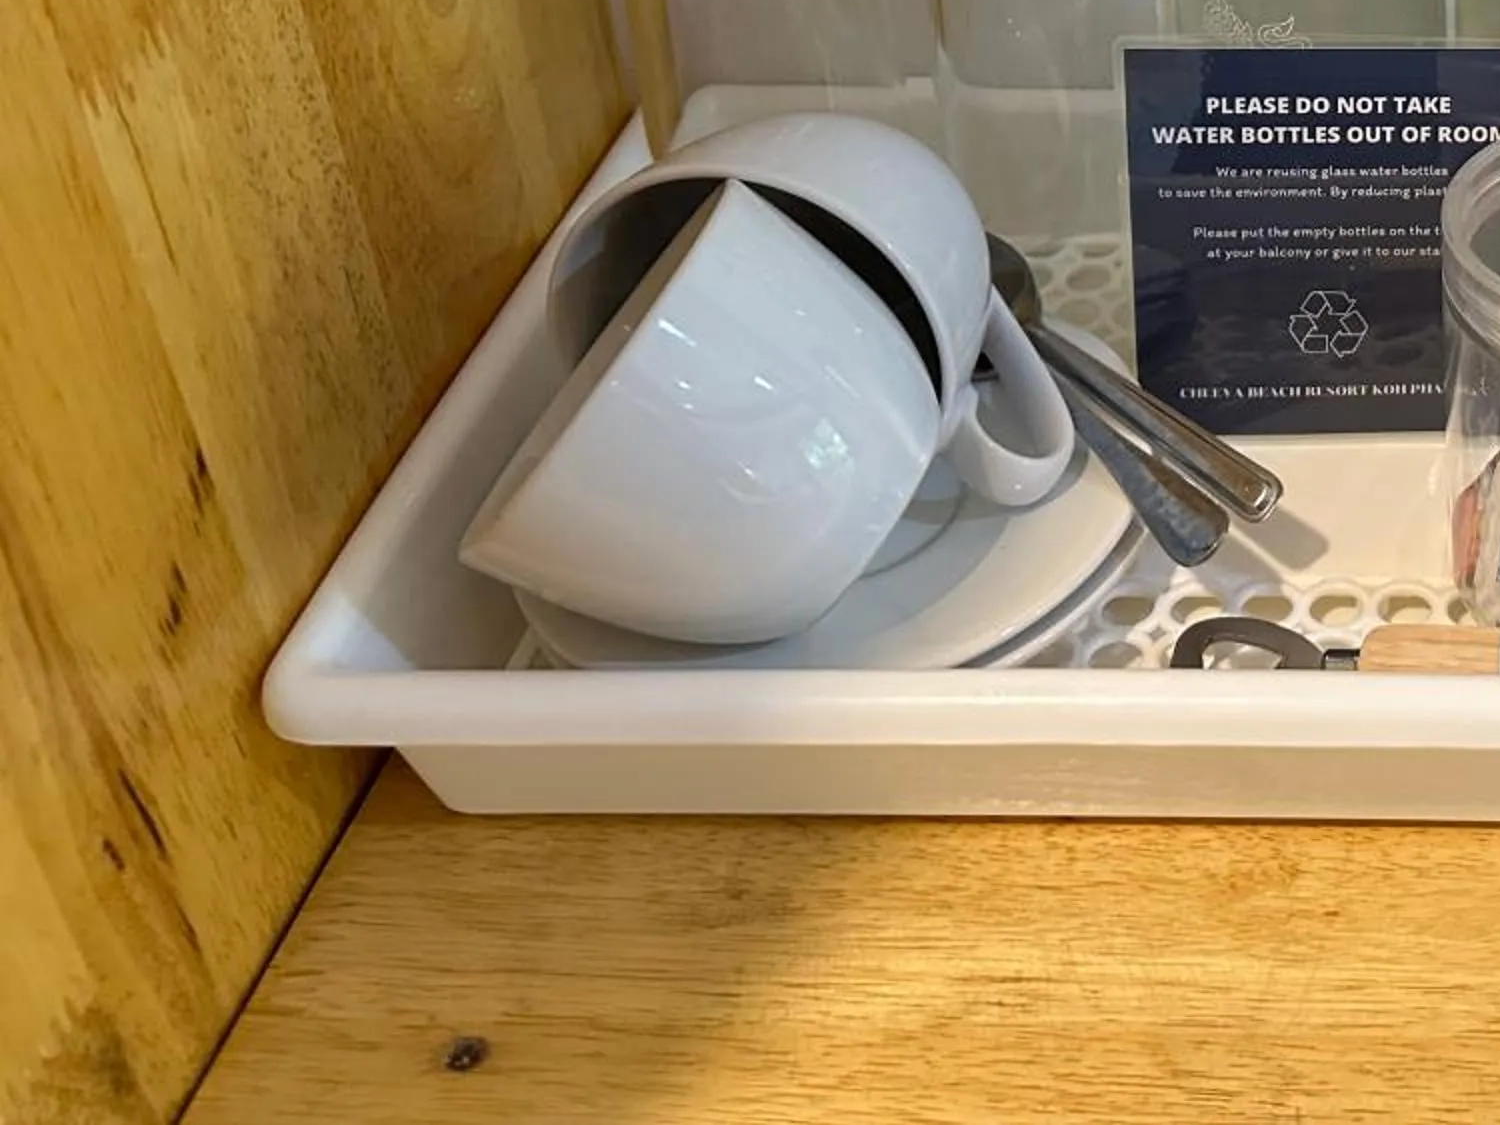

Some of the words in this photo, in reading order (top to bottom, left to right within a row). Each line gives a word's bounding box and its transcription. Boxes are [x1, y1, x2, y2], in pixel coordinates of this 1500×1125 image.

[1206, 96, 1289, 114] PLEASE
[1296, 96, 1331, 114] DO
[1337, 96, 1387, 114] NOT
[1394, 96, 1451, 114] TAKE
[1151, 126, 1235, 144] WATER
[1241, 126, 1341, 144] BOTTLES
[1347, 126, 1395, 143] OUT
[1401, 126, 1432, 143] OF
[1215, 166, 1237, 177] We
[1241, 168, 1263, 177] are
[1267, 167, 1317, 180] reusing
[1321, 166, 1356, 180] glass
[1359, 166, 1399, 176] water
[1401, 165, 1449, 176] bottles
[1158, 188, 1173, 198] to
[1176, 190, 1207, 198] save
[1210, 187, 1232, 198] the
[1330, 187, 1348, 200] By
[1351, 186, 1411, 200] reducing
[1414, 186, 1448, 200] plast
[1193, 227, 1238, 238] Please
[1241, 228, 1264, 241] put
[1267, 226, 1289, 237] the
[1293, 227, 1336, 240] empty
[1339, 226, 1385, 236] bottles
[1389, 228, 1406, 236] on
[1409, 225, 1431, 236] the
[1207, 248, 1221, 258] at
[1224, 249, 1255, 260] your
[1259, 246, 1311, 260] balcony
[1314, 248, 1329, 257] or
[1332, 248, 1359, 260] give
[1362, 247, 1372, 256] it
[1375, 247, 1390, 256] to
[1393, 248, 1416, 256] our
[1419, 246, 1441, 256] sta
[1247, 386, 1301, 397] BEACH
[1305, 384, 1368, 396] RESORT
